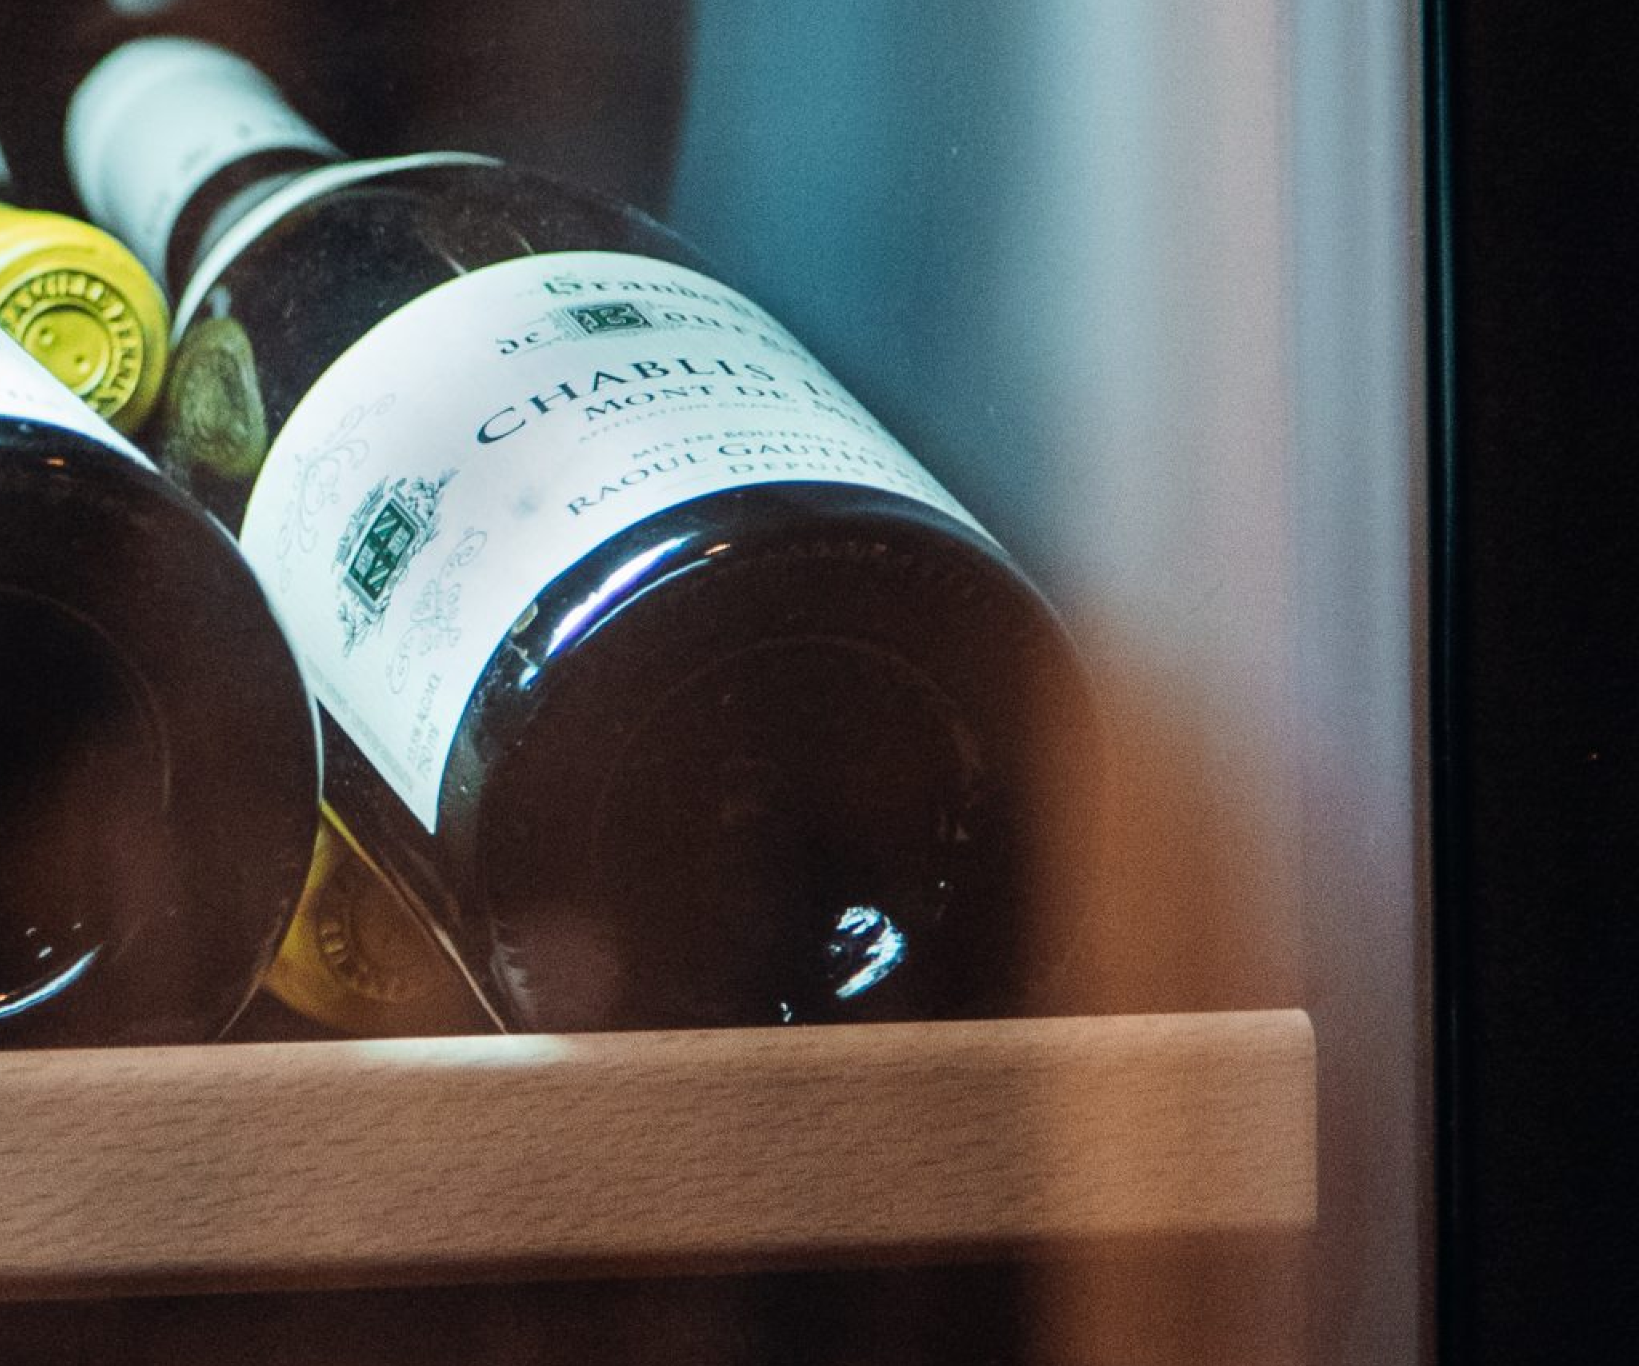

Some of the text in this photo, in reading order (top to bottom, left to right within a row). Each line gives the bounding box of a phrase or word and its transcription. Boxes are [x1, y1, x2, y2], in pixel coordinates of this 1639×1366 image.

[495, 329, 542, 357] de
[475, 355, 778, 446] CHABLIS
[582, 383, 717, 423] MONT
[565, 451, 709, 518] RAOUL
